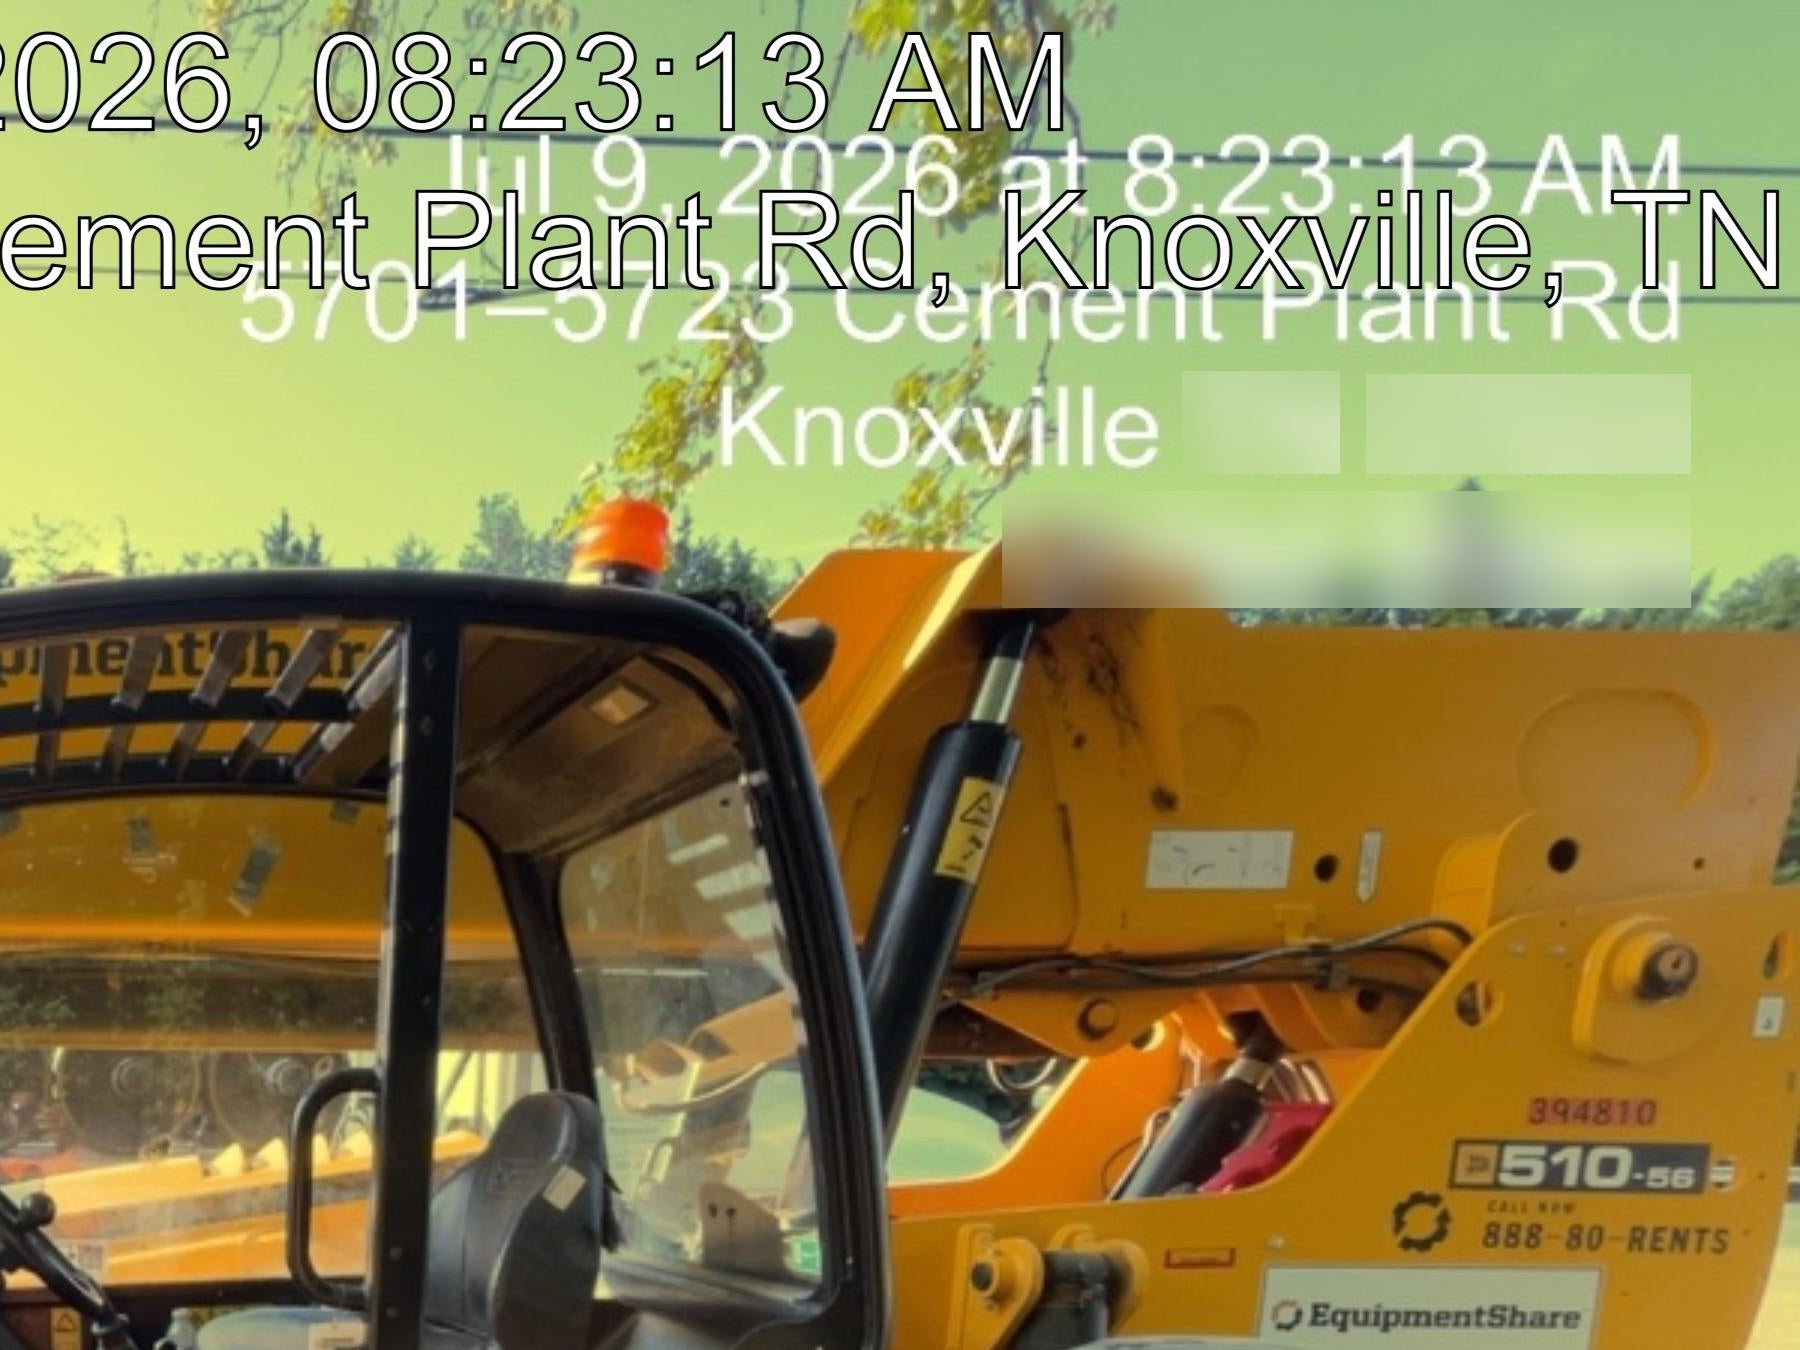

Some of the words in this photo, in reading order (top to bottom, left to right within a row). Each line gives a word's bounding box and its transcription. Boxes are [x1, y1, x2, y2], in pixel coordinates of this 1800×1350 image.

[1528, 1097, 1658, 1127] 394810
[1498, 1144, 1696, 1189] 510-56
[1309, 1303, 1582, 1333] EquipmentShare
